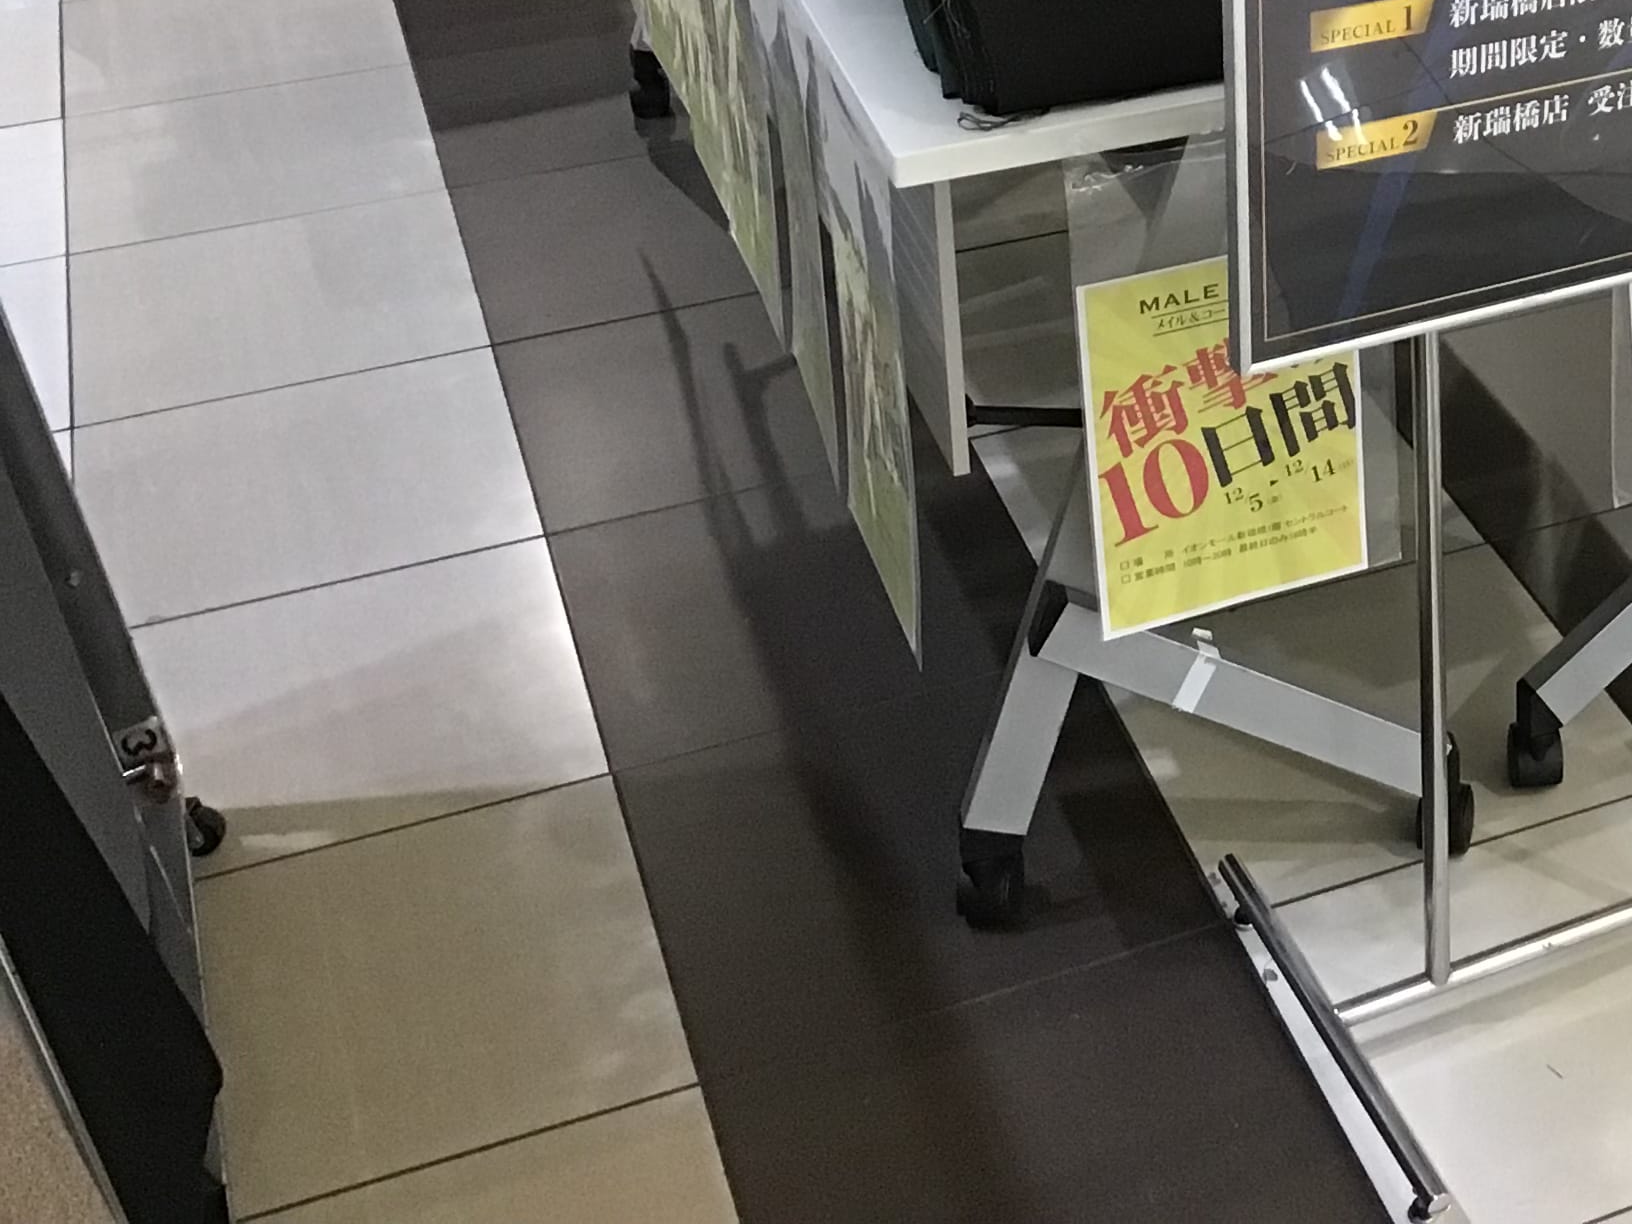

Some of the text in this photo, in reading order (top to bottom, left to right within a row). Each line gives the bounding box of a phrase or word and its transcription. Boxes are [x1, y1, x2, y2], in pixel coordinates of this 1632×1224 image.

[1320, 5, 1414, 46] SPECIAL 1
[1453, 94, 1569, 144] 新瑞橋店
[1327, 119, 1419, 162] SPECIAL 2
[1139, 283, 1220, 315] MALE
